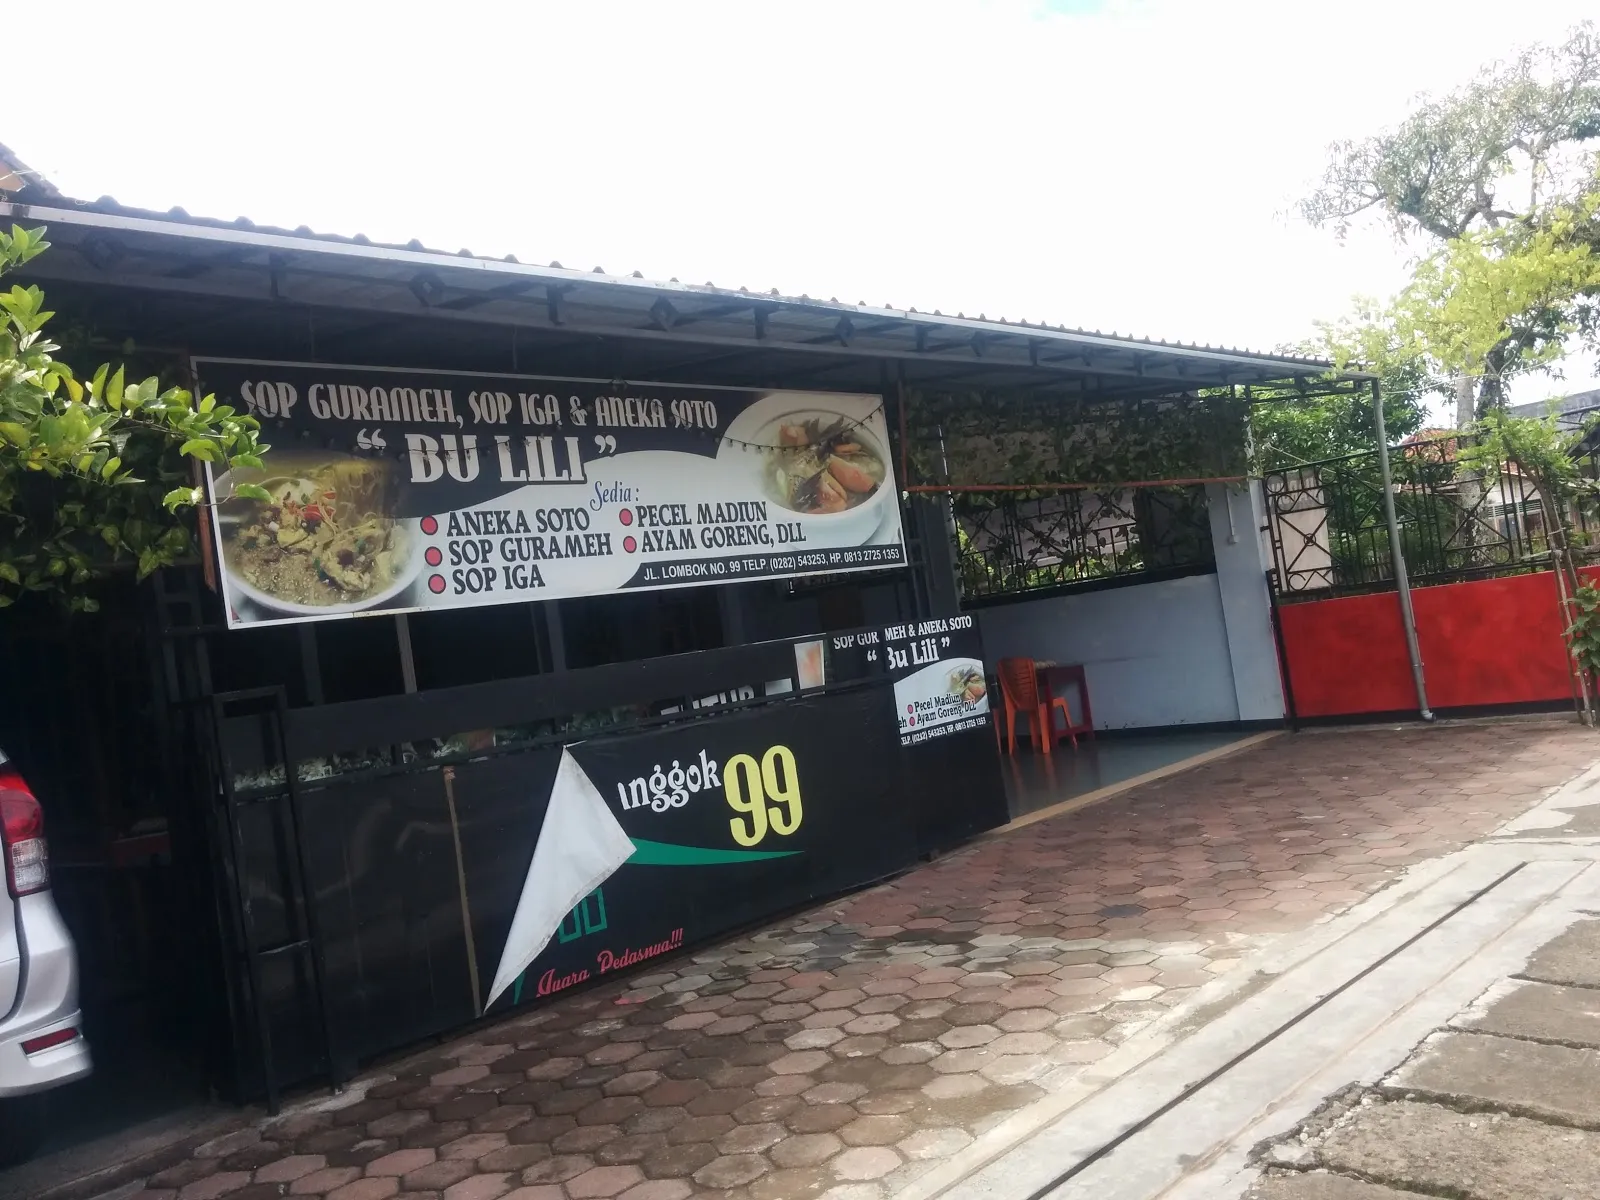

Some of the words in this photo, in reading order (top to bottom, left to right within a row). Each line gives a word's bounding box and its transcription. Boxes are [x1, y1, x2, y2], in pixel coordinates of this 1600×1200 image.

[240, 379, 298, 419] SOP
[308, 382, 464, 429] GURAMEH,
[468, 390, 513, 425] SOP
[519, 393, 561, 427] IGA
[569, 395, 588, 426] &
[595, 396, 667, 429] ANEKA
[670, 399, 718, 430] SOTO
[404, 433, 480, 483] BU
[496, 435, 588, 483] LILI
[446, 508, 532, 538] ANEKA
[535, 506, 590, 533] SOTO
[636, 503, 697, 528] PECEL
[697, 501, 768, 526] MADIUN
[449, 539, 494, 566] SOP
[499, 532, 613, 561] GURAMEH
[641, 528, 697, 553] AYAM
[701, 523, 775, 550] GORENG,
[777, 522, 807, 543] DLL
[453, 566, 498, 596] SOP
[504, 564, 546, 590] IGA
[644, 567, 660, 581] JL.
[662, 563, 709, 579] LOMBOK
[710, 562, 728, 575] NO.
[729, 560, 741, 573] 99
[769, 556, 796, 572] (0282)
[797, 553, 829, 567] 543253,
[829, 552, 843, 564] HP.
[844, 550, 863, 563] 0813
[863, 549, 882, 561] 2725
[882, 548, 900, 559] 1353
[833, 634, 855, 650] SOP
[908, 624, 916, 637] &
[918, 618, 948, 636] ANEKA
[949, 615, 972, 630] SOTO
[910, 638, 940, 665] Lili
[914, 697, 933, 713] Pecel
[934, 693, 961, 708] Madiun
[916, 710, 937, 726] Ayam
[723, 745, 803, 847] 99
